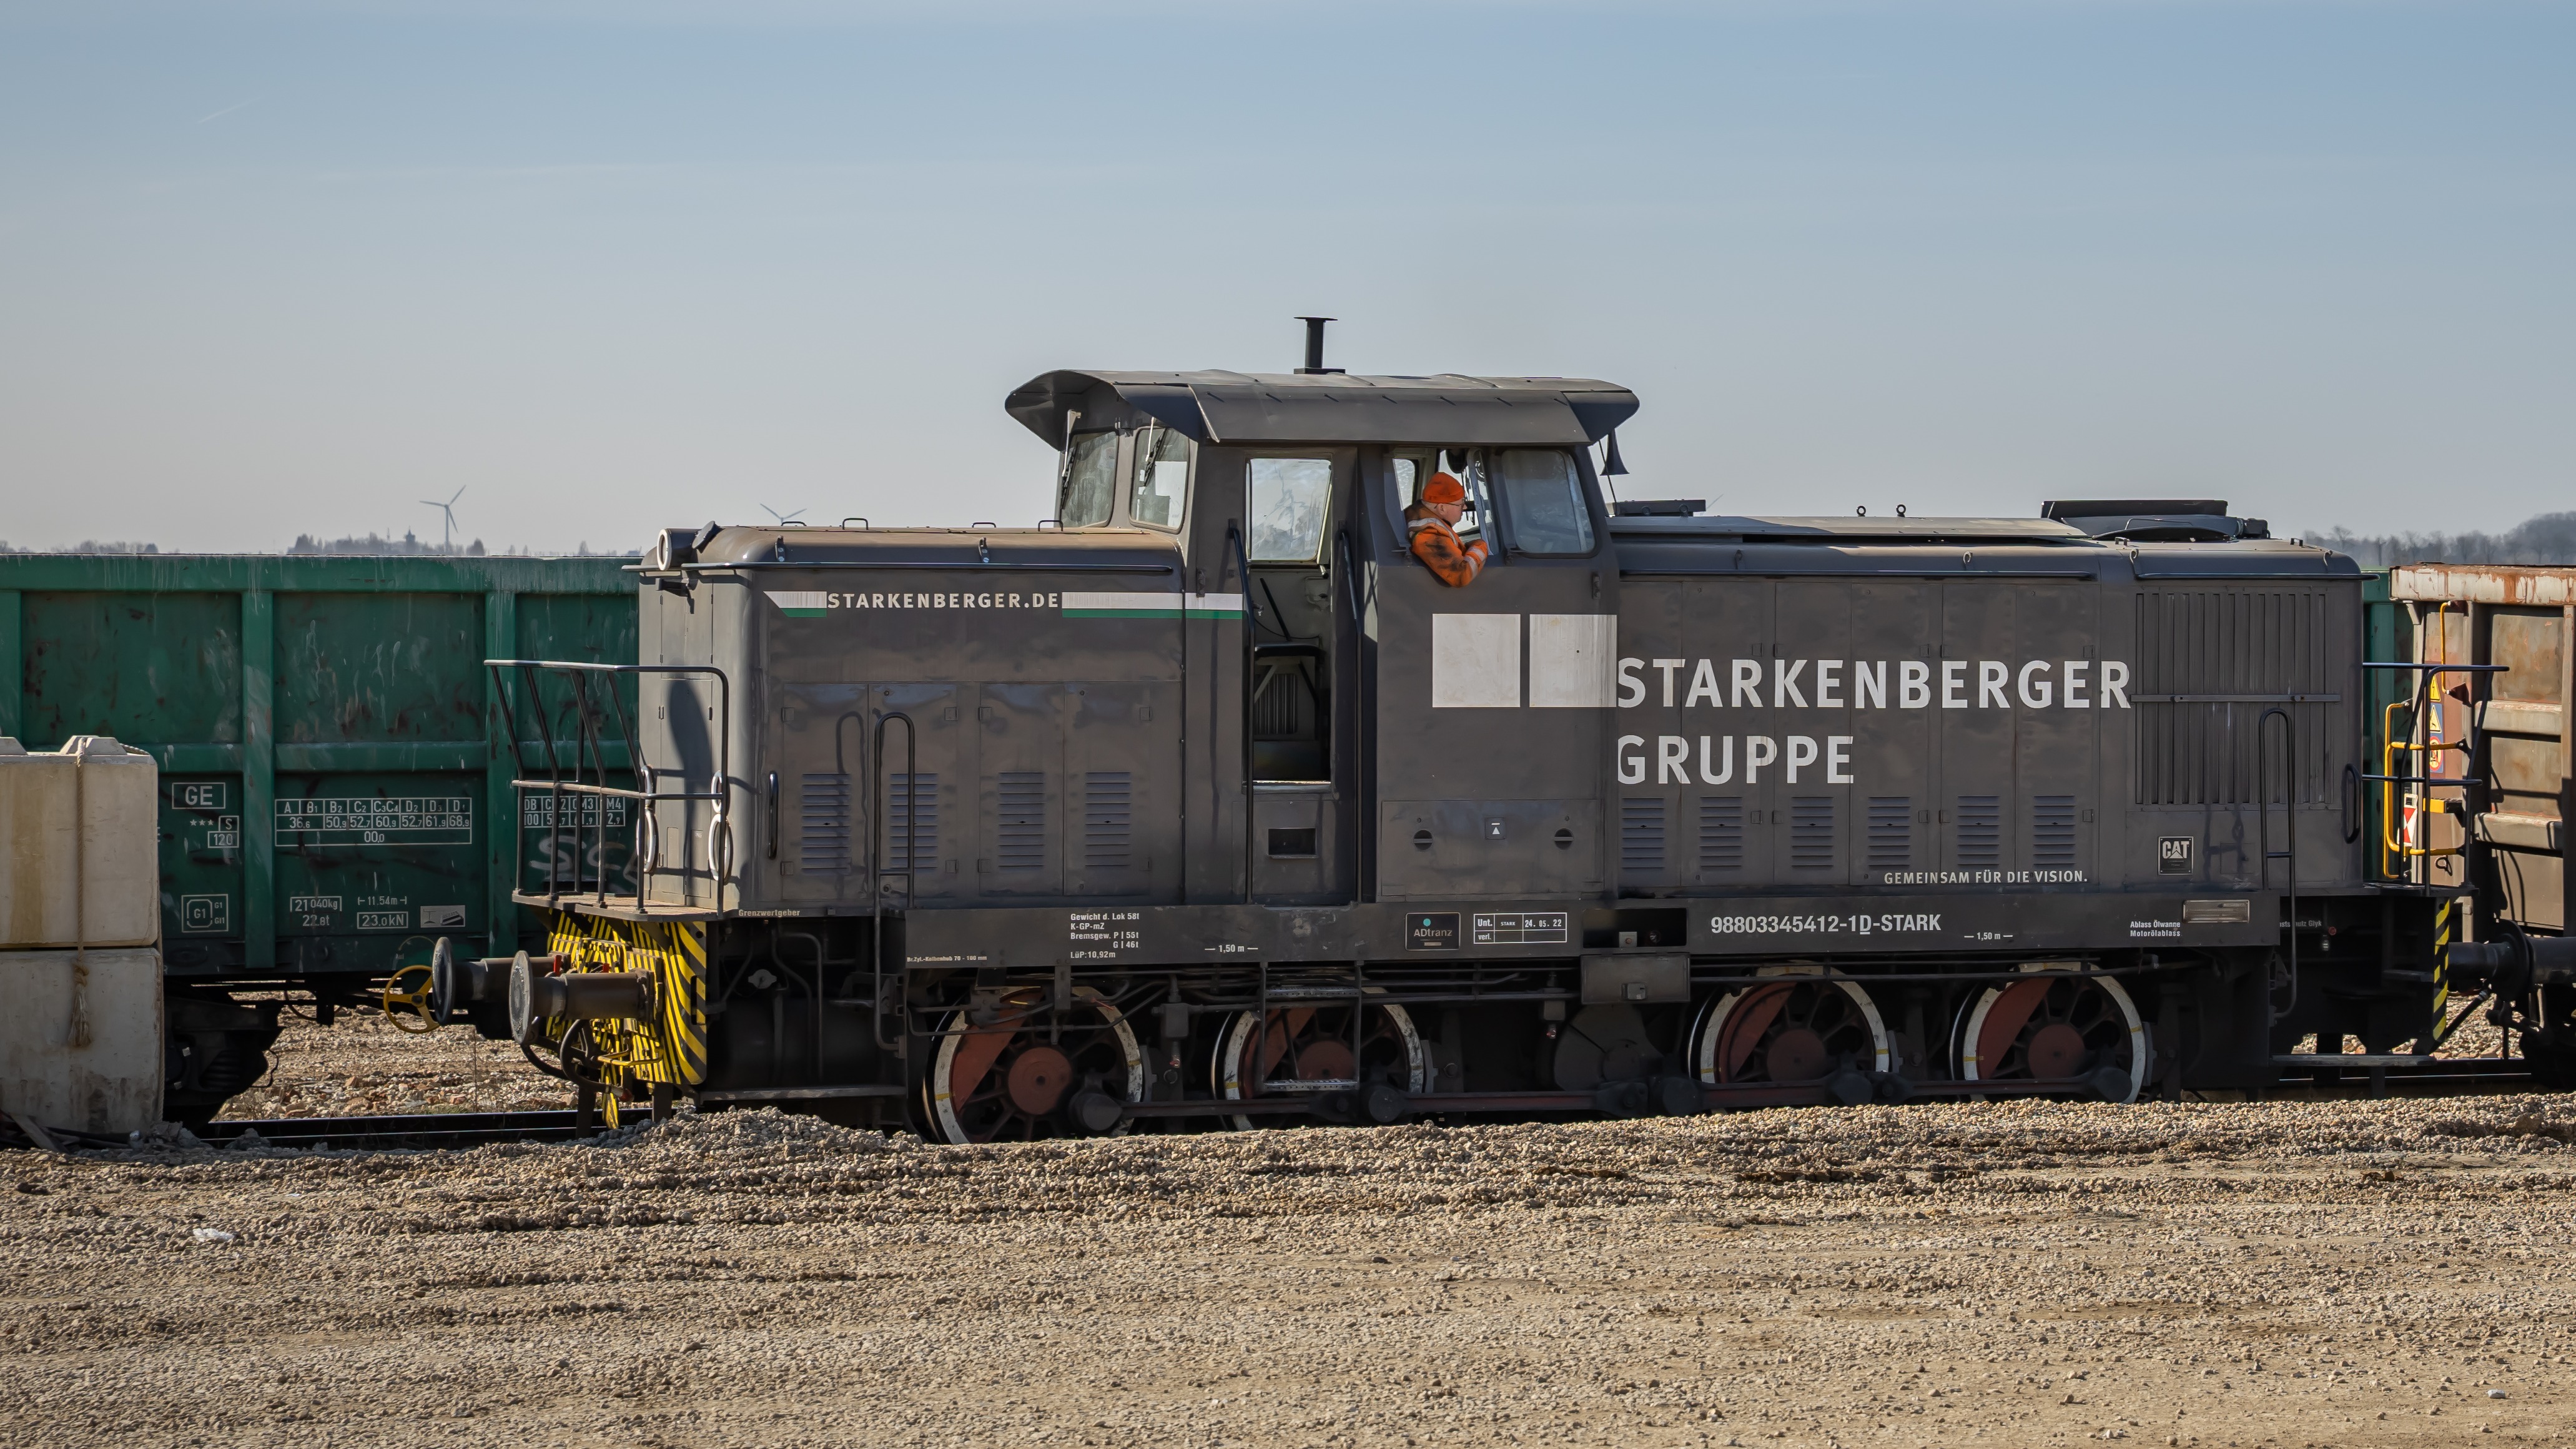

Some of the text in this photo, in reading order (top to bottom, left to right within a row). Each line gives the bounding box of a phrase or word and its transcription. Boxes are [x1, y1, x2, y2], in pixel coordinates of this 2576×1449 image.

[827, 593, 1058, 609] STARKENBERGER.DE
[1617, 657, 2131, 709] STARKENBERGER
[1617, 734, 1854, 785] GRUPPE
[185, 786, 212, 806] GE
[284, 801, 292, 814] A
[330, 801, 342, 813] B2
[353, 801, 367, 813] C2
[406, 801, 418, 812] D2
[545, 798, 566, 810] C2
[225, 818, 232, 829] S
[289, 815, 469, 829] 36.6 50.9 52.7 60.9 52.7 61.9 68.9
[546, 813, 565, 825] 5.7
[574, 813, 593, 825] 1.9
[214, 833, 233, 846] 120
[364, 831, 385, 843] 00.0
[2162, 841, 2189, 859] CAT
[1884, 869, 2088, 884] GEMEINSAM FÜR DIE VISION.
[368, 896, 398, 905] 11.54m
[194, 908, 206, 919] G1
[738, 909, 801, 917] Grenzwertgeber
[1070, 912, 1101, 921] Gewicht
[362, 914, 404, 927] 23.0kN
[1477, 918, 1493, 927] Unt.
[1524, 919, 1536, 927] 24.
[1552, 919, 1562, 927] 22
[1710, 914, 1942, 934] 98803345412-1D-STARK
[2153, 919, 2181, 928] Ölwanne
[1070, 932, 1112, 941] Bremsgew.
[1413, 928, 1453, 937] ADtranz
[1976, 932, 1993, 941] 1,50
[1218, 944, 1236, 953] 1,50
